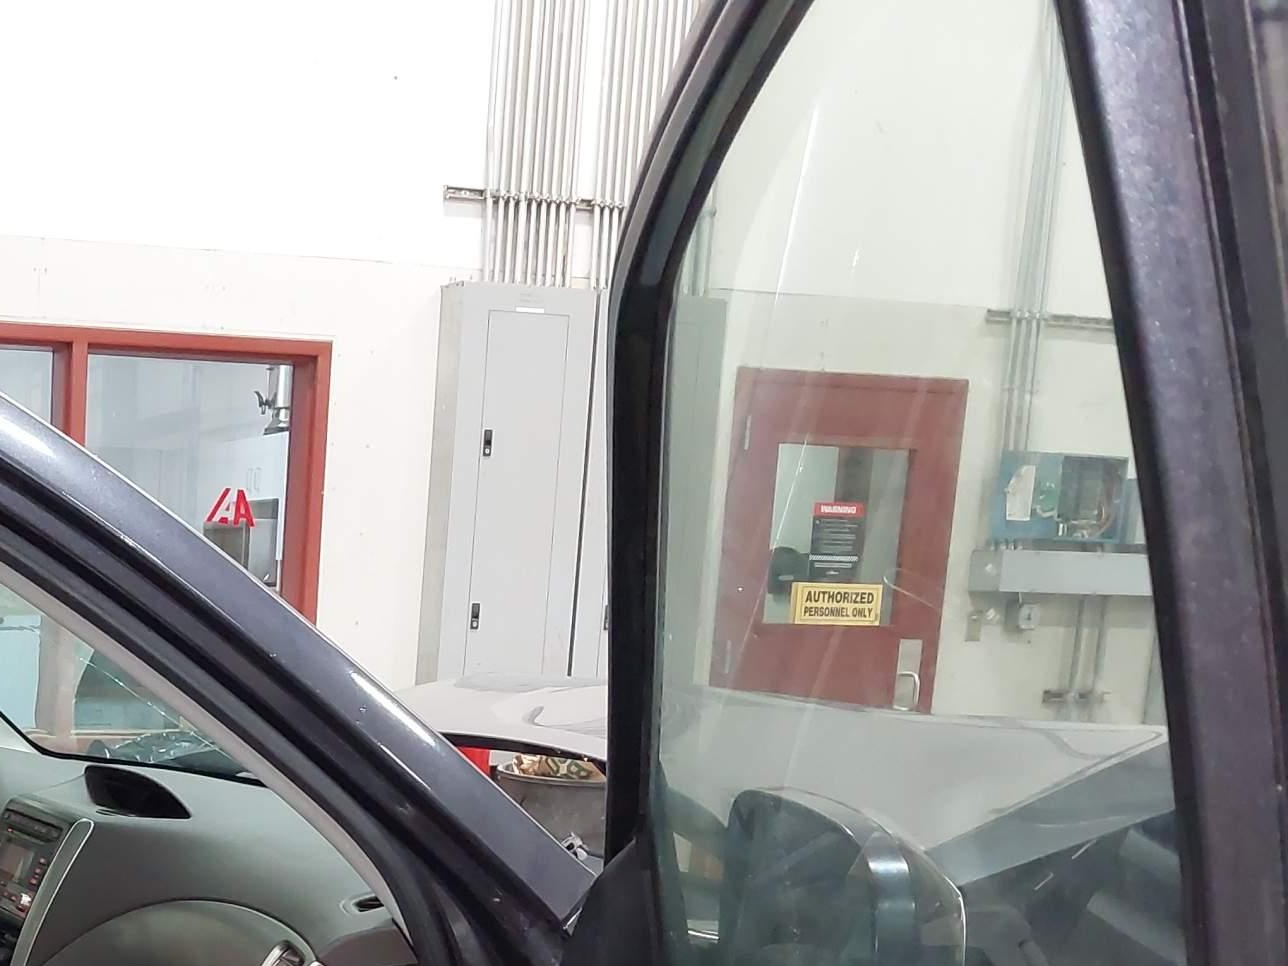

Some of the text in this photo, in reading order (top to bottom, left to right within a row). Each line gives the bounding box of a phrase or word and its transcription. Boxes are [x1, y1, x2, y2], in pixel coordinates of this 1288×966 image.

[805, 591, 874, 604] AUTHORIZED
[803, 606, 873, 618] PERSONNEL ONLY
